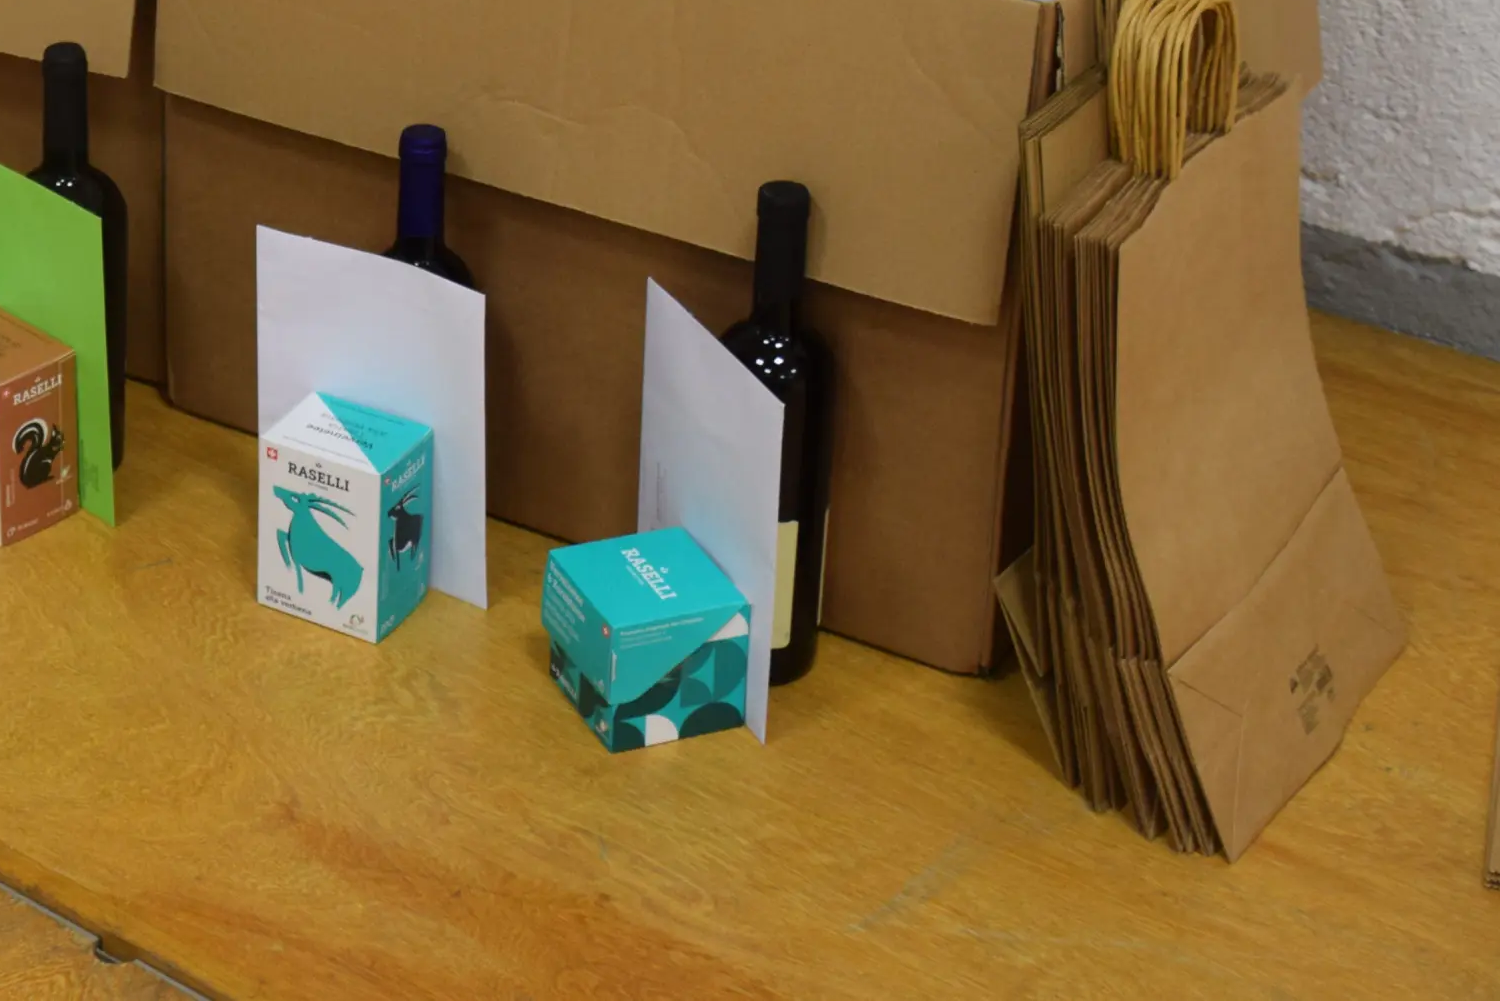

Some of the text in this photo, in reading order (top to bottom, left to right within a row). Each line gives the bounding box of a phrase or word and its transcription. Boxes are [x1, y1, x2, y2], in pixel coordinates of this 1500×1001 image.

[12, 374, 63, 406] RASELLI
[288, 461, 350, 492] RASELLI
[391, 454, 426, 492] RASELLI
[620, 547, 677, 600] RASELLI
